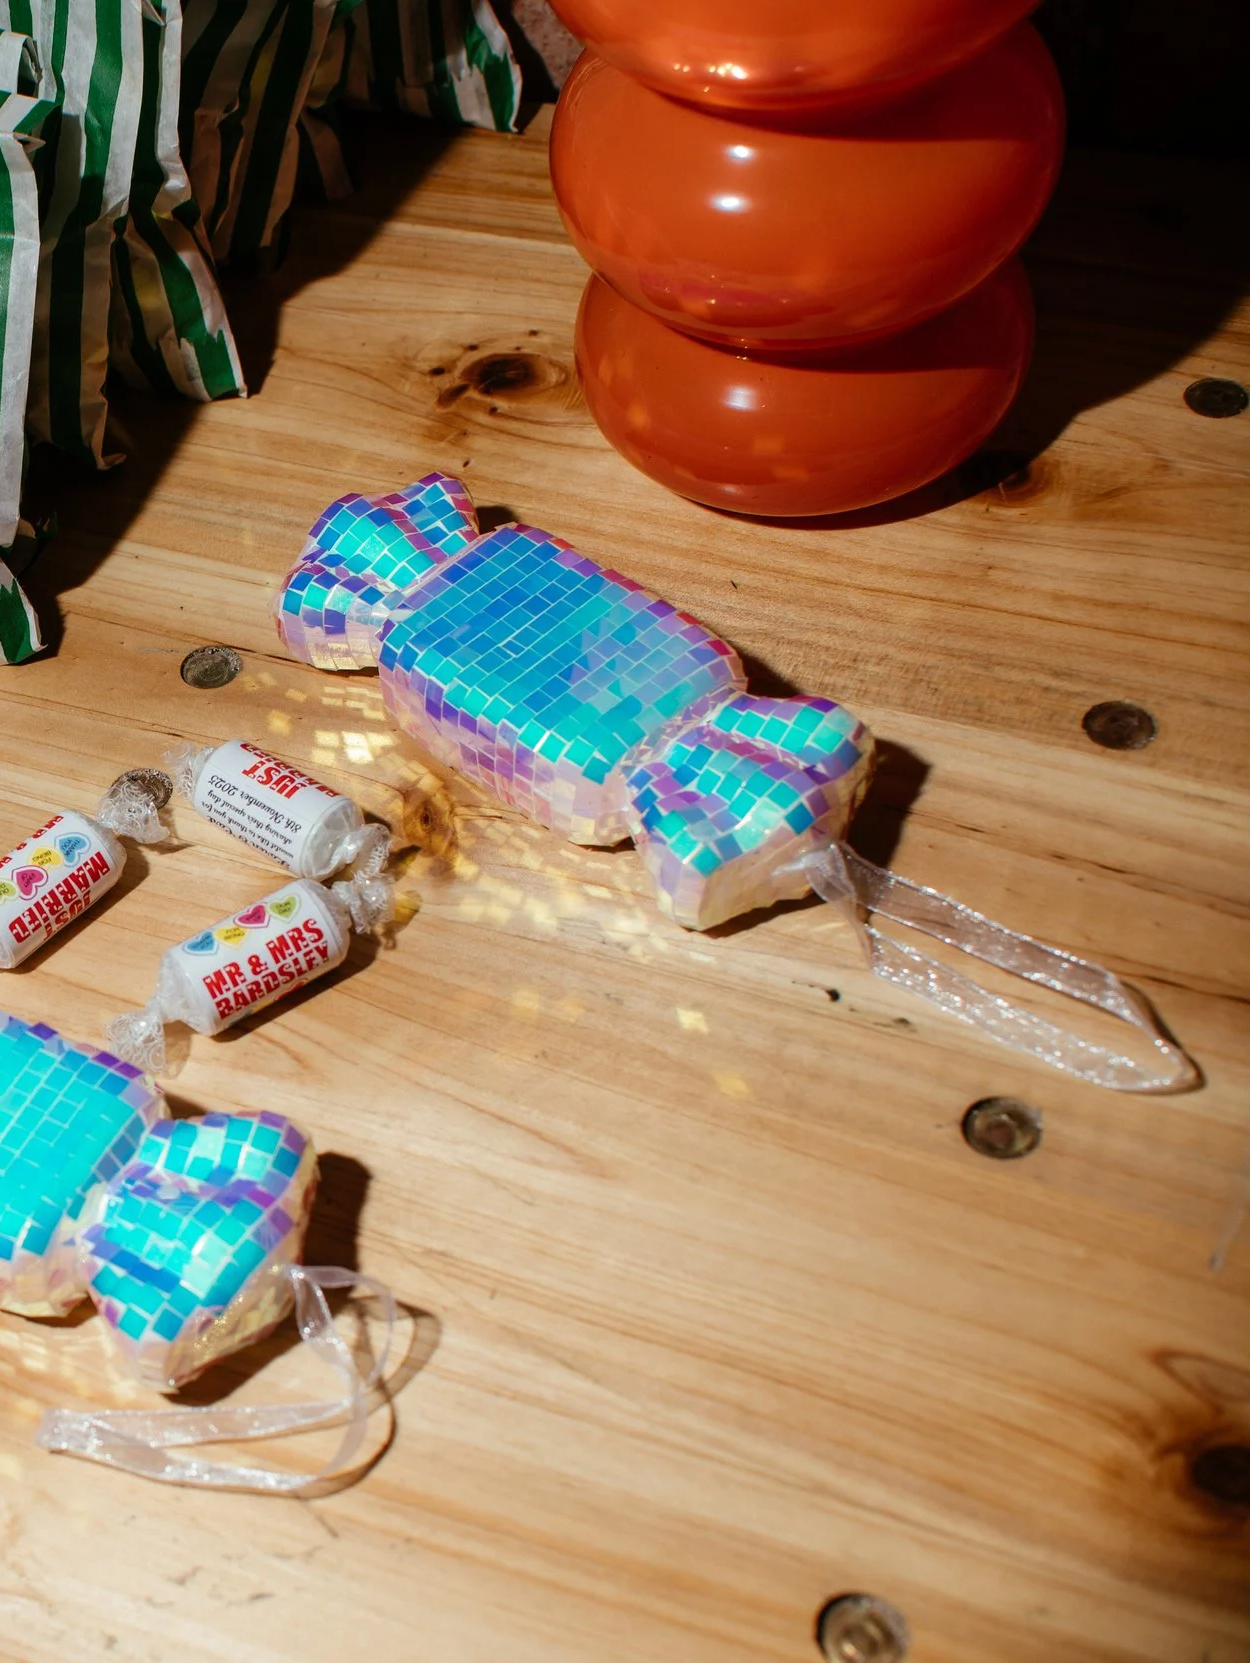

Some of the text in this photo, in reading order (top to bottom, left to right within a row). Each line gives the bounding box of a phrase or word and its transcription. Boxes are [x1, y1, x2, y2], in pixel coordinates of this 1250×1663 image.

[242, 760, 307, 799] JUST
[201, 800, 213, 812] for
[207, 774, 302, 833] 8th November 2025
[207, 790, 292, 844] sharing their special day
[212, 807, 226, 818] you
[227, 816, 247, 832] thank
[248, 829, 255, 837] to
[257, 834, 270, 846] like
[31, 849, 52, 862] BEING
[38, 857, 52, 866] FOR
[8, 851, 110, 943] MARRIED
[202, 918, 325, 999] MR & MRS
[215, 940, 329, 1020] BARDSLEY
